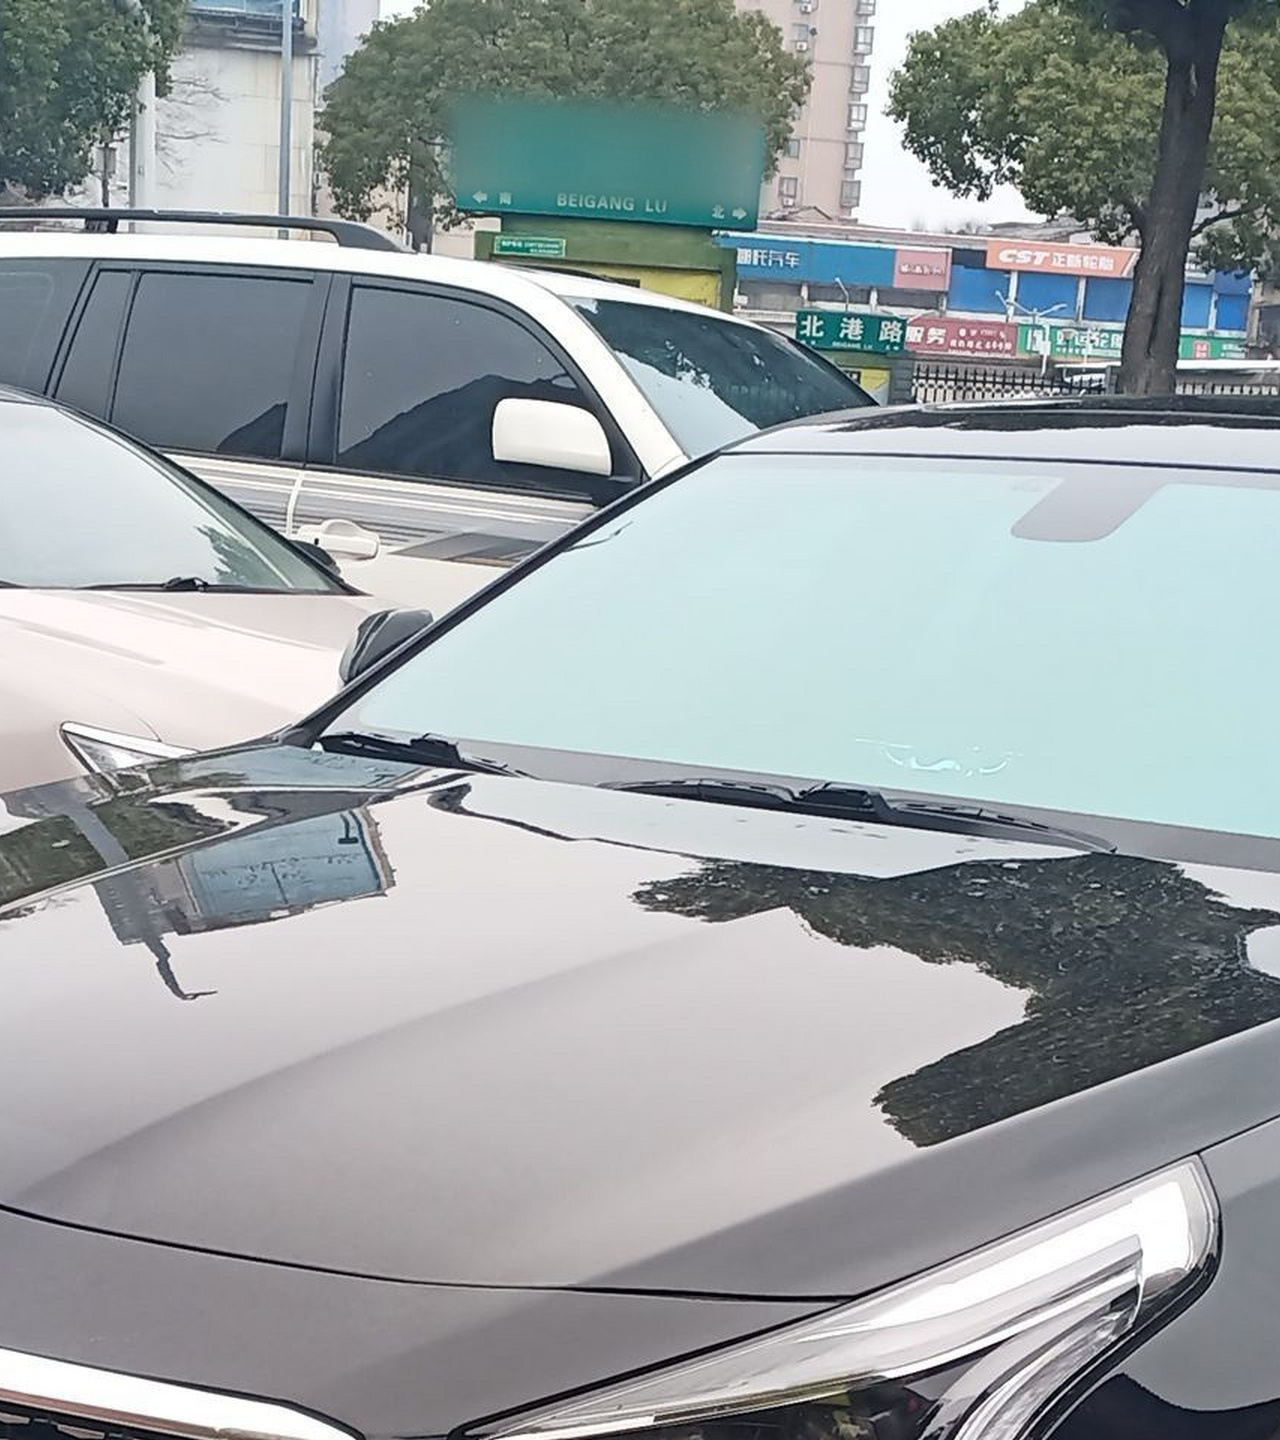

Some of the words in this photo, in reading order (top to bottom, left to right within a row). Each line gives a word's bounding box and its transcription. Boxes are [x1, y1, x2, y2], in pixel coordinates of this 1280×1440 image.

[557, 192, 634, 211] BEIGANG
[645, 199, 667, 213] LU
[712, 205, 725, 219] 北
[999, 249, 1050, 265] CST
[800, 315, 903, 344] 北港路
